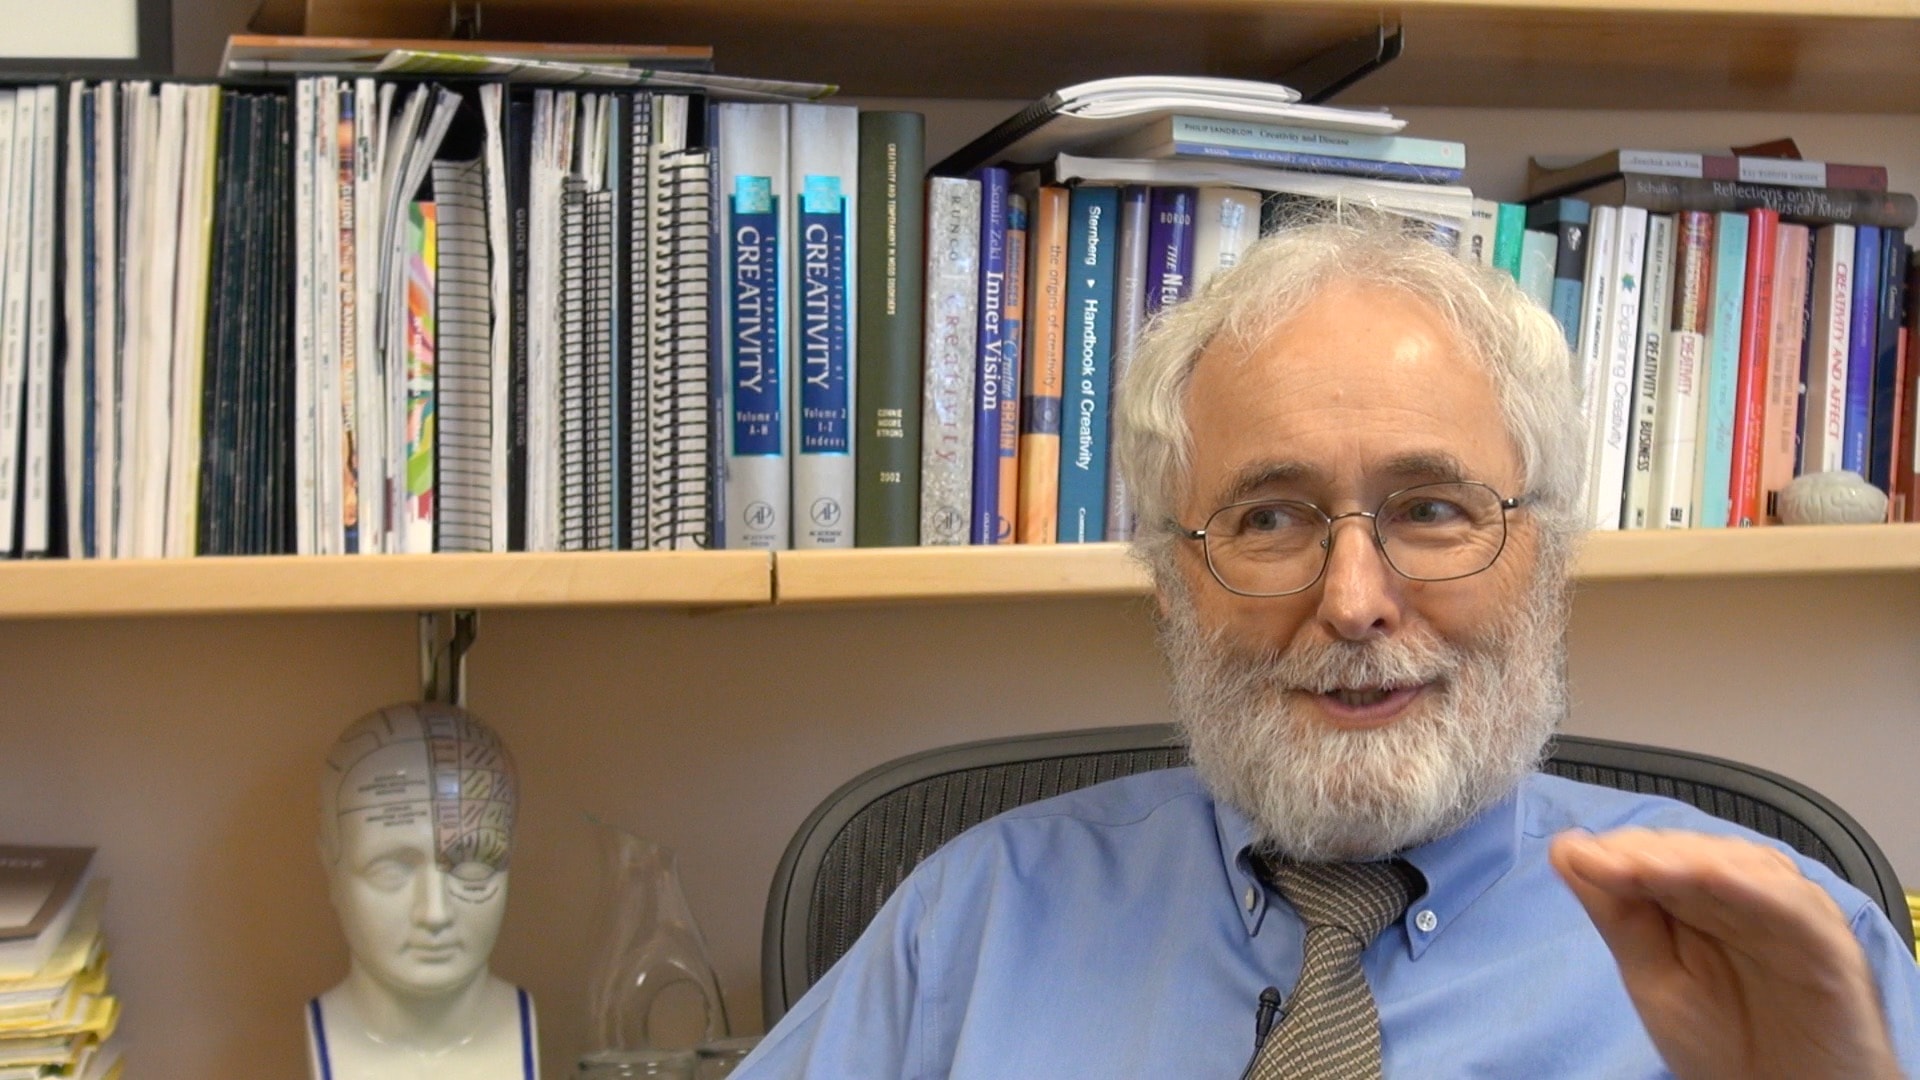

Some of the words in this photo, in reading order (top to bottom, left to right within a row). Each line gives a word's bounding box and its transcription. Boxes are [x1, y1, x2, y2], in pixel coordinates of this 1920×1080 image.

[1259, 130, 1299, 141] Creativity
[1301, 132, 1317, 141] and
[1319, 134, 1350, 146] Disease
[887, 143, 897, 182] CREATIVITY
[342, 183, 355, 229] GUIDE
[887, 184, 896, 198] AND
[989, 184, 1004, 225] Semir
[1713, 181, 1784, 201] Reflections
[1786, 189, 1804, 201] on
[1806, 189, 1828, 204] the
[1765, 198, 1816, 217] Musical
[1819, 201, 1852, 219] Mind
[515, 208, 527, 251] GUIDE
[887, 200, 896, 247] TEMPERAMENT
[948, 195, 962, 262] RUNCO
[989, 230, 1002, 260] Zeki
[1084, 205, 1102, 265] Sternberg
[1051, 245, 1061, 265] the
[1165, 244, 1179, 272] THE
[736, 225, 763, 394] CREATIVITY
[764, 237, 777, 354] Encyclopedia
[805, 223, 830, 389] CREATIVITY
[832, 235, 844, 351] Encyclopedia
[985, 270, 1004, 333] Inner
[1047, 269, 1061, 310] origins
[1833, 262, 1848, 342] CREATIVITY
[1047, 315, 1059, 329] of
[1083, 299, 1099, 376] Handbook
[1613, 303, 1635, 377] Explaining
[515, 324, 526, 381] ANNUAL
[833, 365, 844, 382] of
[983, 340, 1002, 411] Vision
[1002, 339, 1018, 399] Creative
[1044, 333, 1058, 389] creativity
[1643, 332, 1660, 401] CREATIVITY
[1677, 335, 1696, 397] CREATIVITY
[1831, 346, 1843, 381] AND
[767, 368, 778, 385] of
[1081, 379, 1096, 396] of
[736, 411, 770, 423] Volume
[803, 407, 837, 419] Volume
[841, 407, 847, 419] 2
[1000, 400, 1016, 449] BRAIN
[1076, 398, 1095, 470] Creativity
[1607, 381, 1628, 450] Creativity
[1829, 384, 1841, 440] AFFECT
[805, 435, 845, 447] Indexes
[1637, 420, 1654, 472] BUSINESS
[880, 471, 901, 483] 2002
